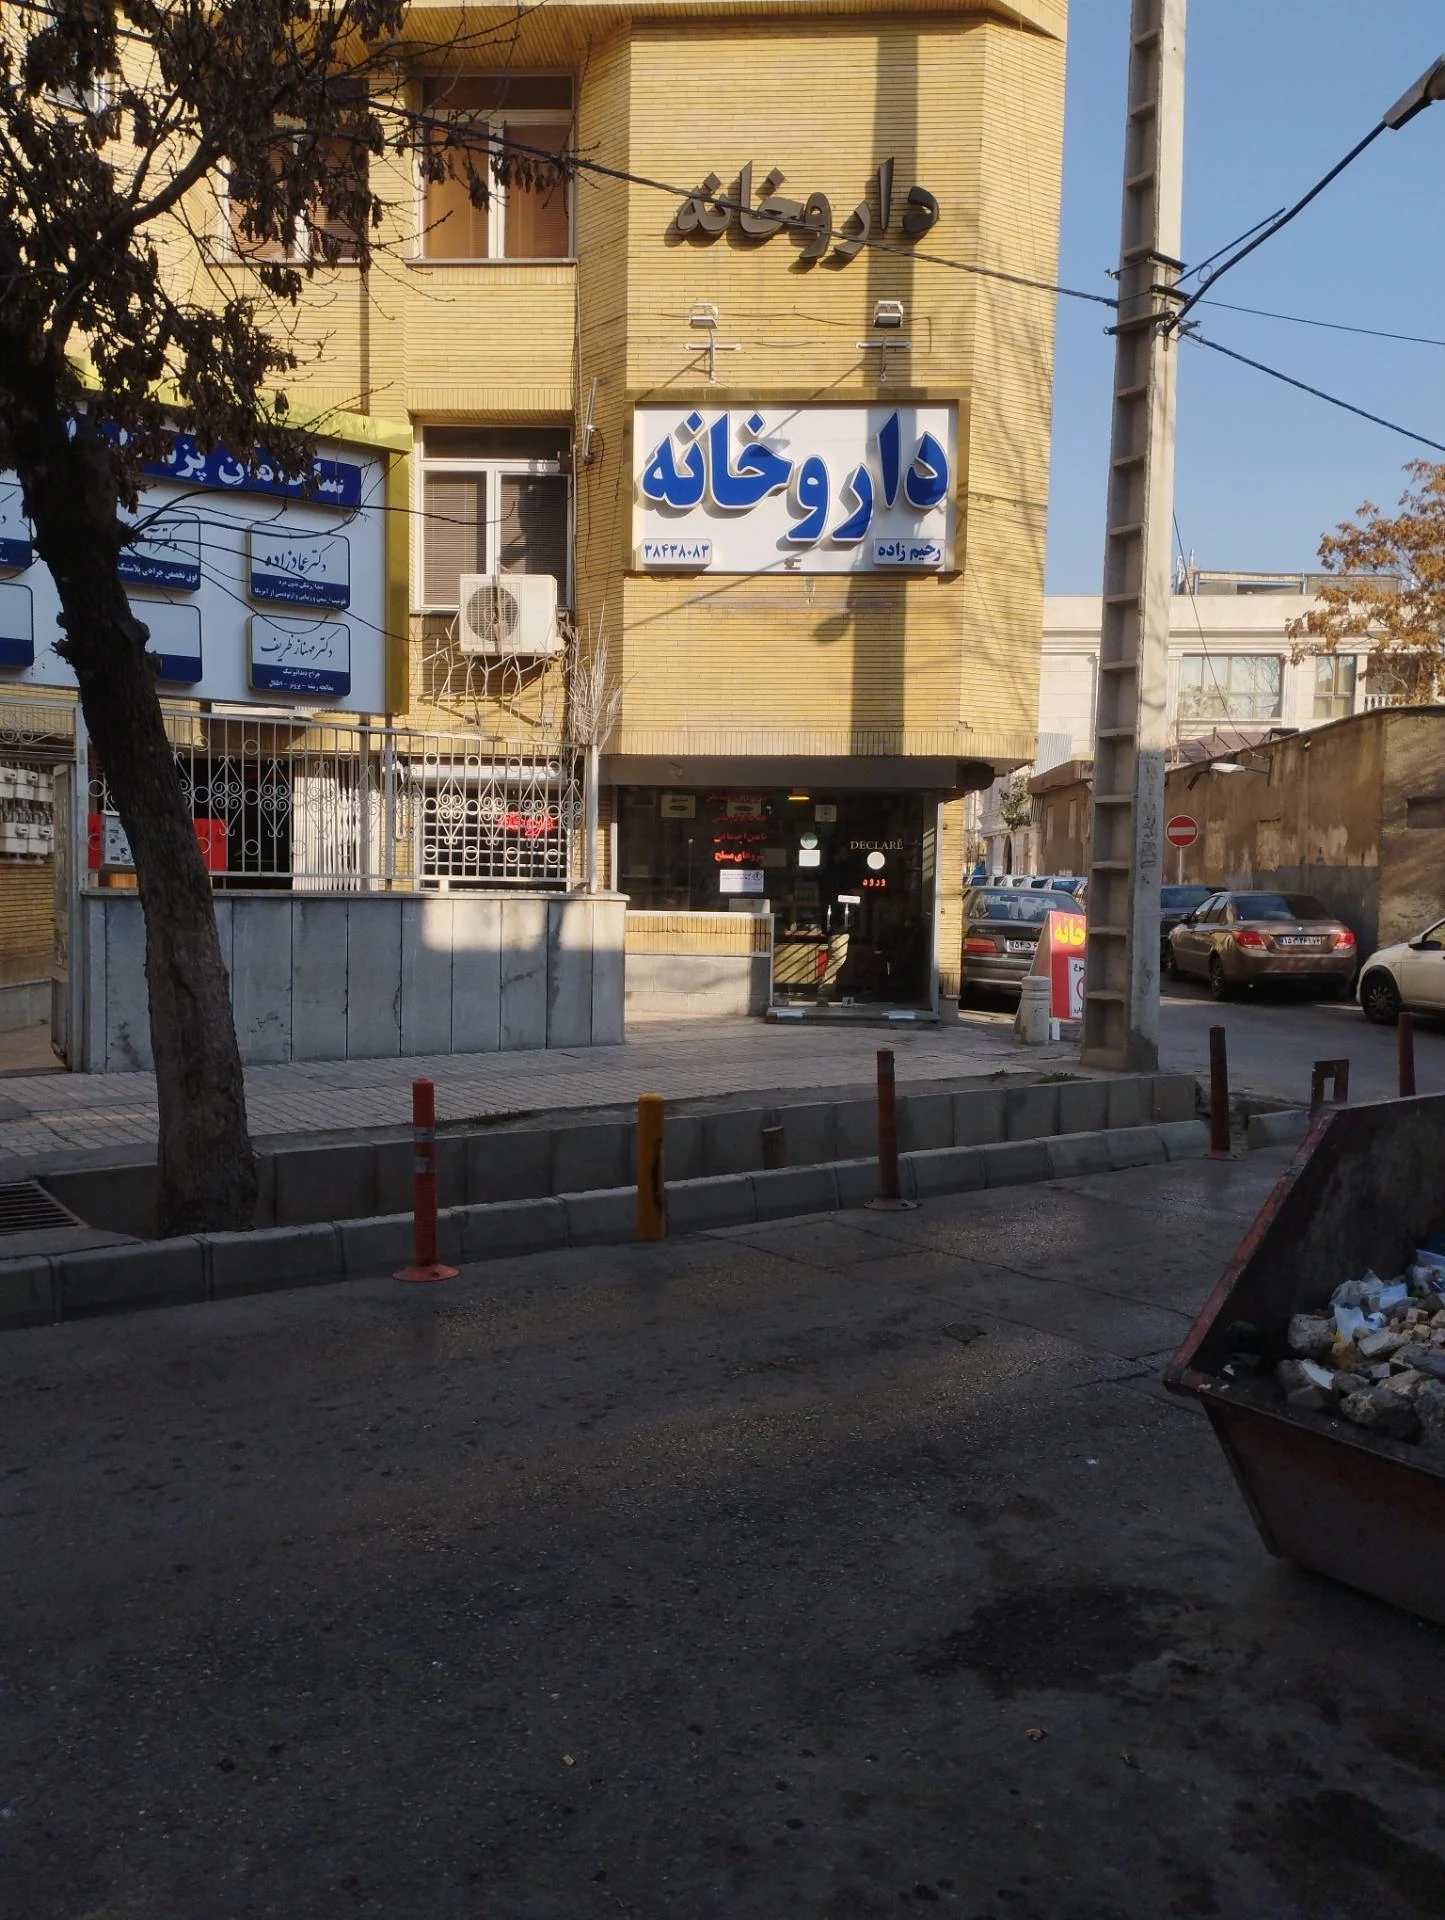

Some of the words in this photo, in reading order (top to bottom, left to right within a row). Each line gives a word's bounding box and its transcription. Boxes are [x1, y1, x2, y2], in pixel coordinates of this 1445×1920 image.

[676, 155, 939, 259] داروخانه
[641, 409, 950, 542] داروخانه
[302, 541, 336, 575] دکتر
[877, 541, 907, 561] زاده
[910, 542, 942, 562] رحیم
[117, 562, 141, 576] پلاستیک
[142, 567, 164, 578] جراحی
[164, 570, 186, 580] تخصص
[260, 633, 295, 662] ظریف
[294, 639, 315, 656] مهناز
[312, 628, 341, 661] دکتر
[308, 670, 321, 679] جراح
[849, 837, 904, 851] DECLARÉ
[861, 876, 887, 888] ورود
